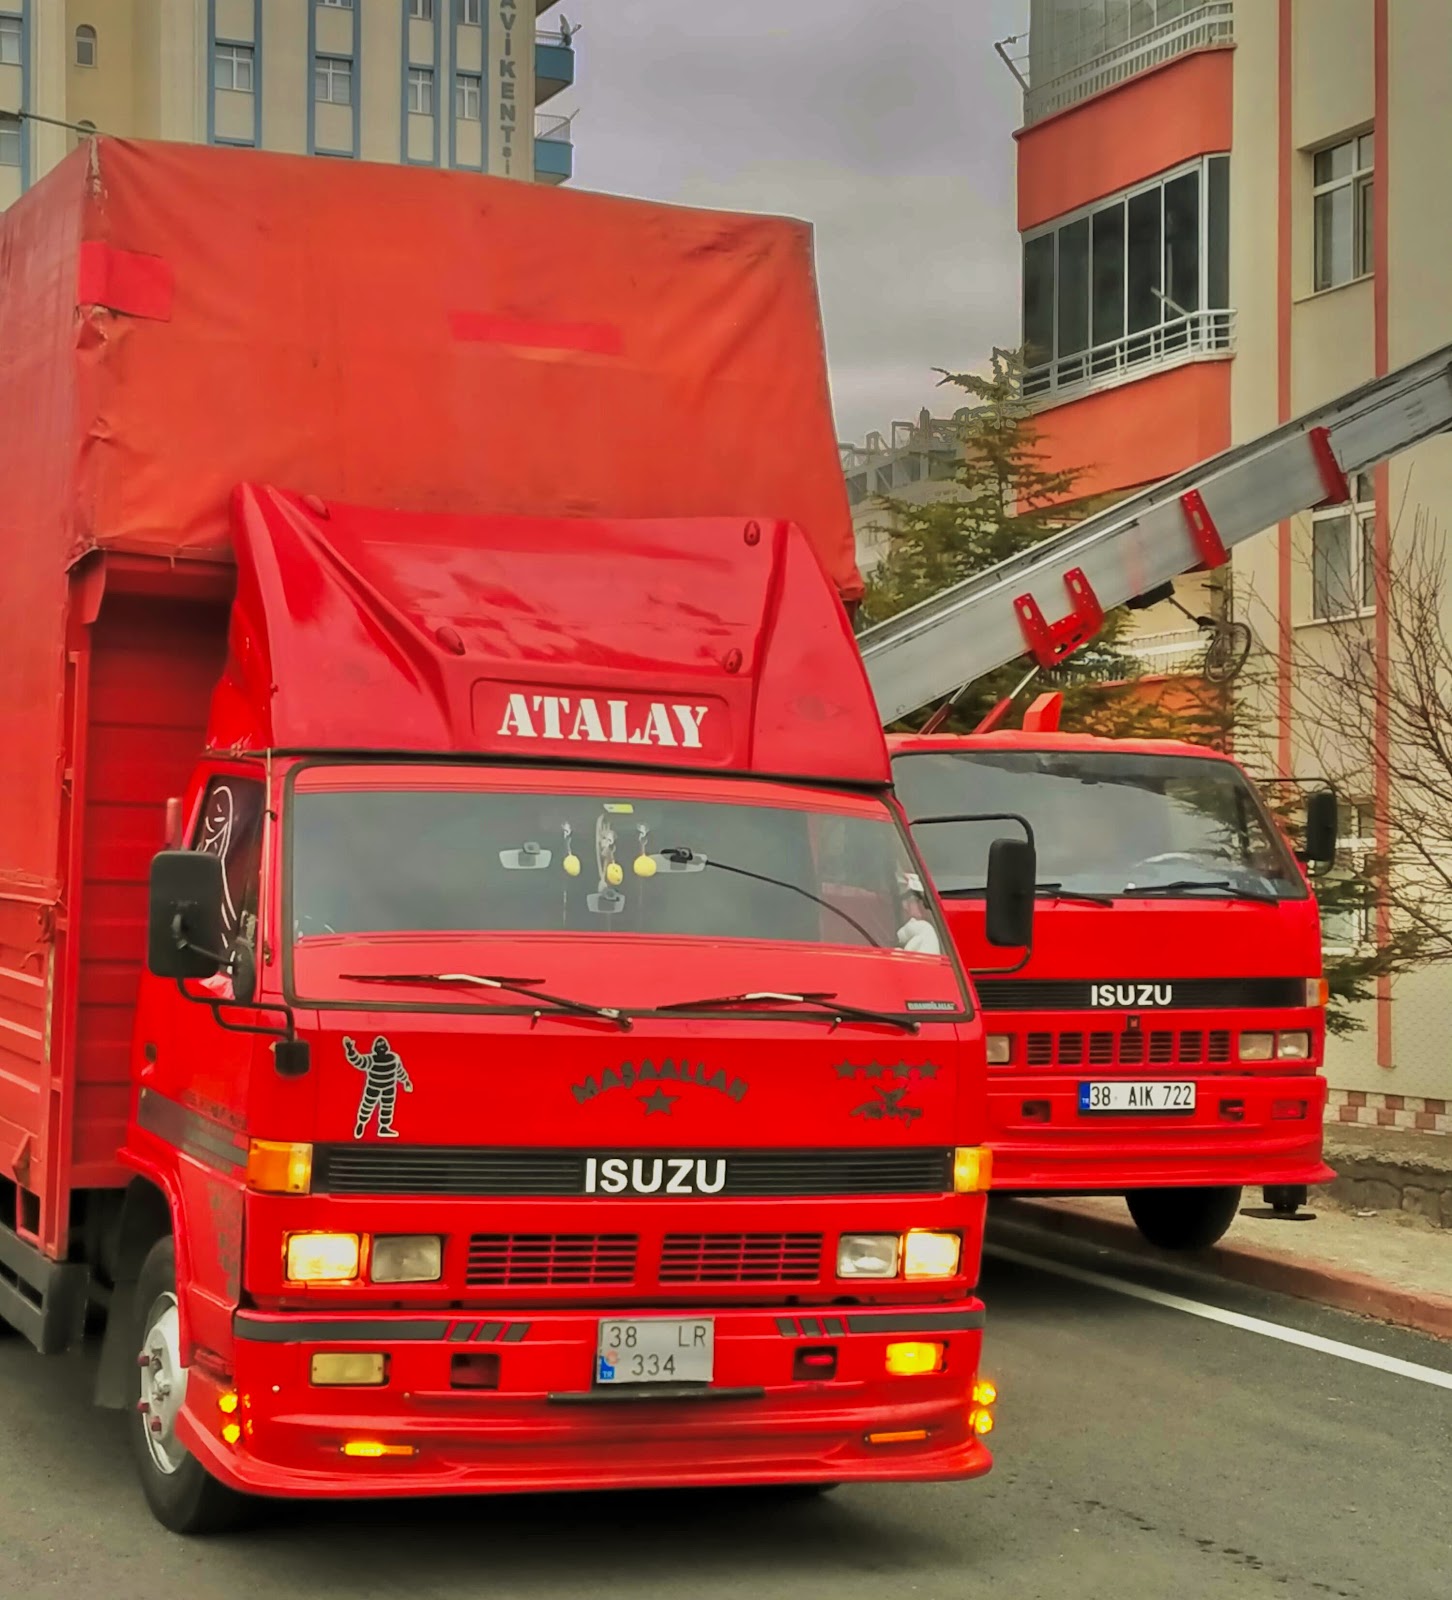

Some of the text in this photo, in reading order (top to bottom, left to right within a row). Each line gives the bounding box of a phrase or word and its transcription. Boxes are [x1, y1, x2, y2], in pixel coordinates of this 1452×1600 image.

[497, 693, 708, 748] ATALAY
[1091, 984, 1172, 1006] ISUZU
[1091, 1086, 1111, 1106] 38
[1128, 1086, 1153, 1106] AIK
[1163, 1085, 1192, 1106] 722
[585, 1158, 727, 1193] ISUZU
[609, 1325, 706, 1348] 38 LR
[602, 1354, 676, 1378] TR 334
